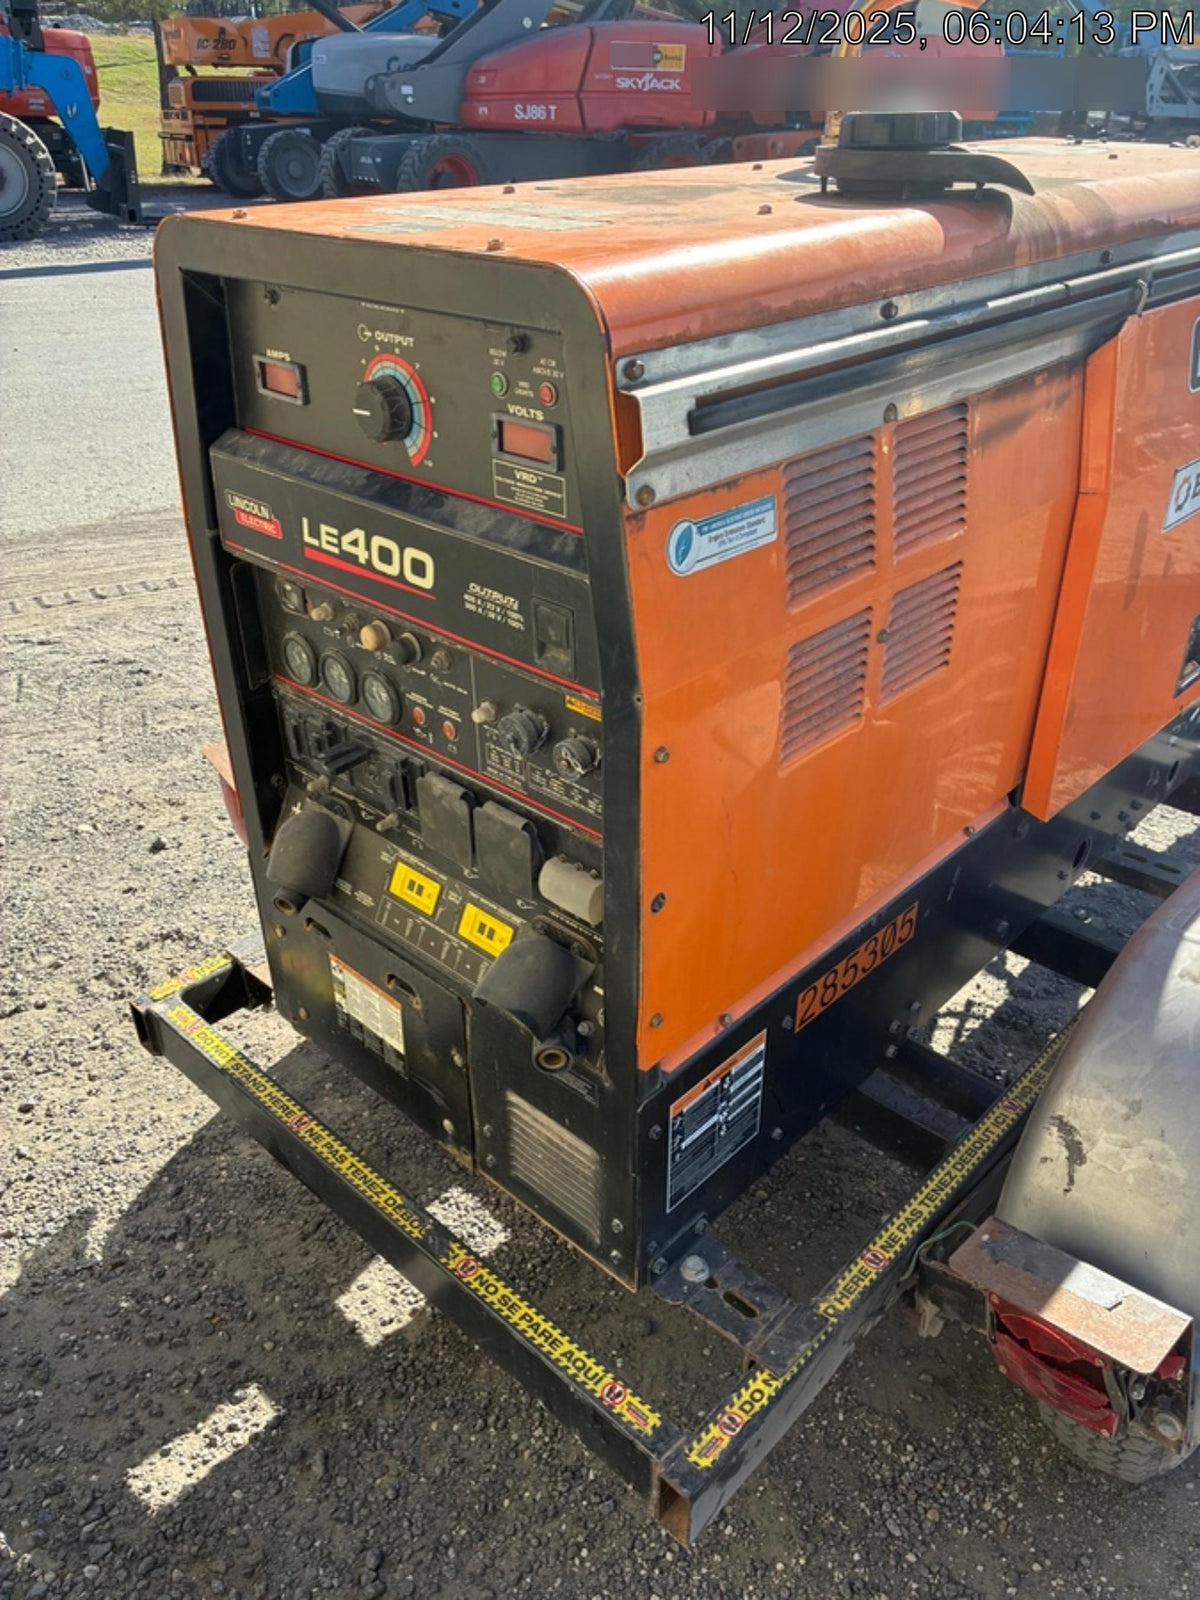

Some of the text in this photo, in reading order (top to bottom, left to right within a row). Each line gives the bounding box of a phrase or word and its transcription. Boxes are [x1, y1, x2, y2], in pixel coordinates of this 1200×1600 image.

[616, 72, 681, 91] SKYJACK
[514, 103, 557, 120] SJ86 T
[266, 348, 291, 362] AMPS
[374, 330, 415, 347] OUTPUT
[507, 403, 545, 421] VOLTS
[227, 493, 271, 520] LINCOLN
[301, 516, 435, 590] LE400
[797, 904, 915, 1028] 285305
[230, 1060, 268, 1094] STAND
[265, 1091, 297, 1118] HERE
[304, 1127, 322, 1144] NE
[321, 1141, 348, 1166] PAS
[345, 1162, 387, 1197] TENEZ
[881, 1231, 903, 1254] NE
[896, 1208, 924, 1235] PAS
[919, 1170, 957, 1209] TENEZ
[952, 1126, 995, 1171] DEBOUT
[833, 1265, 873, 1306] HERE
[473, 1273, 499, 1296] NO
[497, 1293, 522, 1316] SE
[519, 1311, 564, 1353] PARE
[738, 1388, 766, 1415] DO
